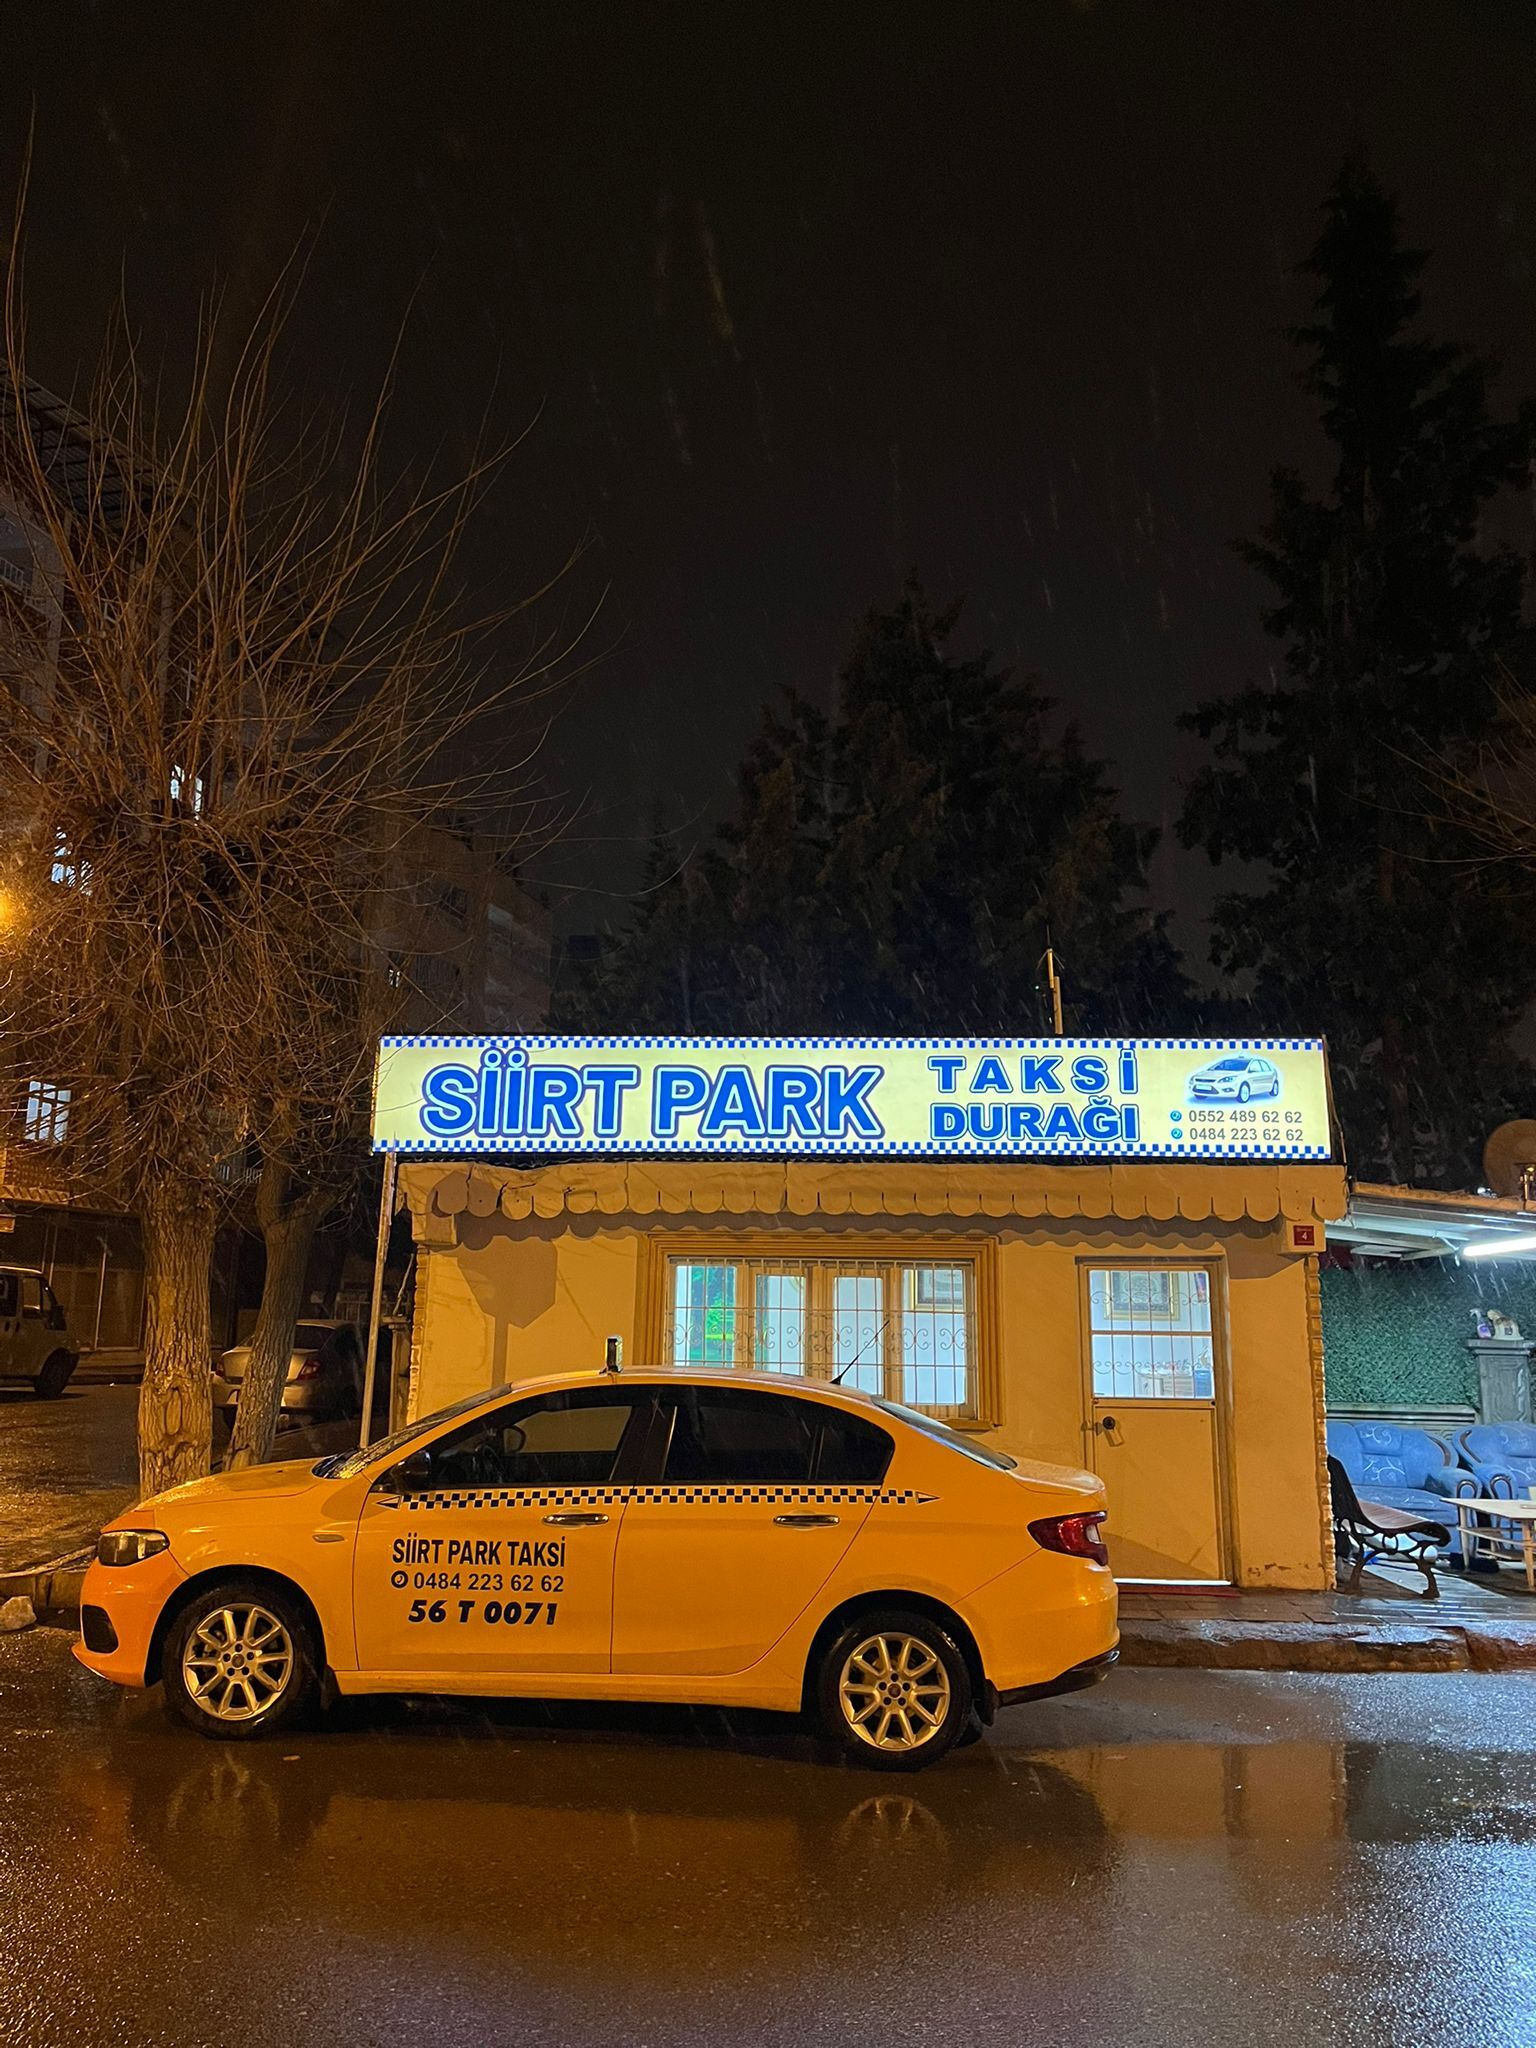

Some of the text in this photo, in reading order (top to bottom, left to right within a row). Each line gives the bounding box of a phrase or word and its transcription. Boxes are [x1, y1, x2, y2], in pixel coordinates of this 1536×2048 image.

[928, 1048, 1139, 1095] TAKSİ
[421, 1048, 885, 1139] SİİRT PARK
[930, 1096, 1140, 1142] DURAĞI
[1188, 1110, 1303, 1124] 0552 489 62 62
[1189, 1128, 1304, 1141] 0484 223 62 62
[392, 1532, 566, 1567] SİİRT PARK TAKSİ
[413, 1572, 564, 1593] 0484 223 62 62
[408, 1600, 558, 1625] 56 T 0071
